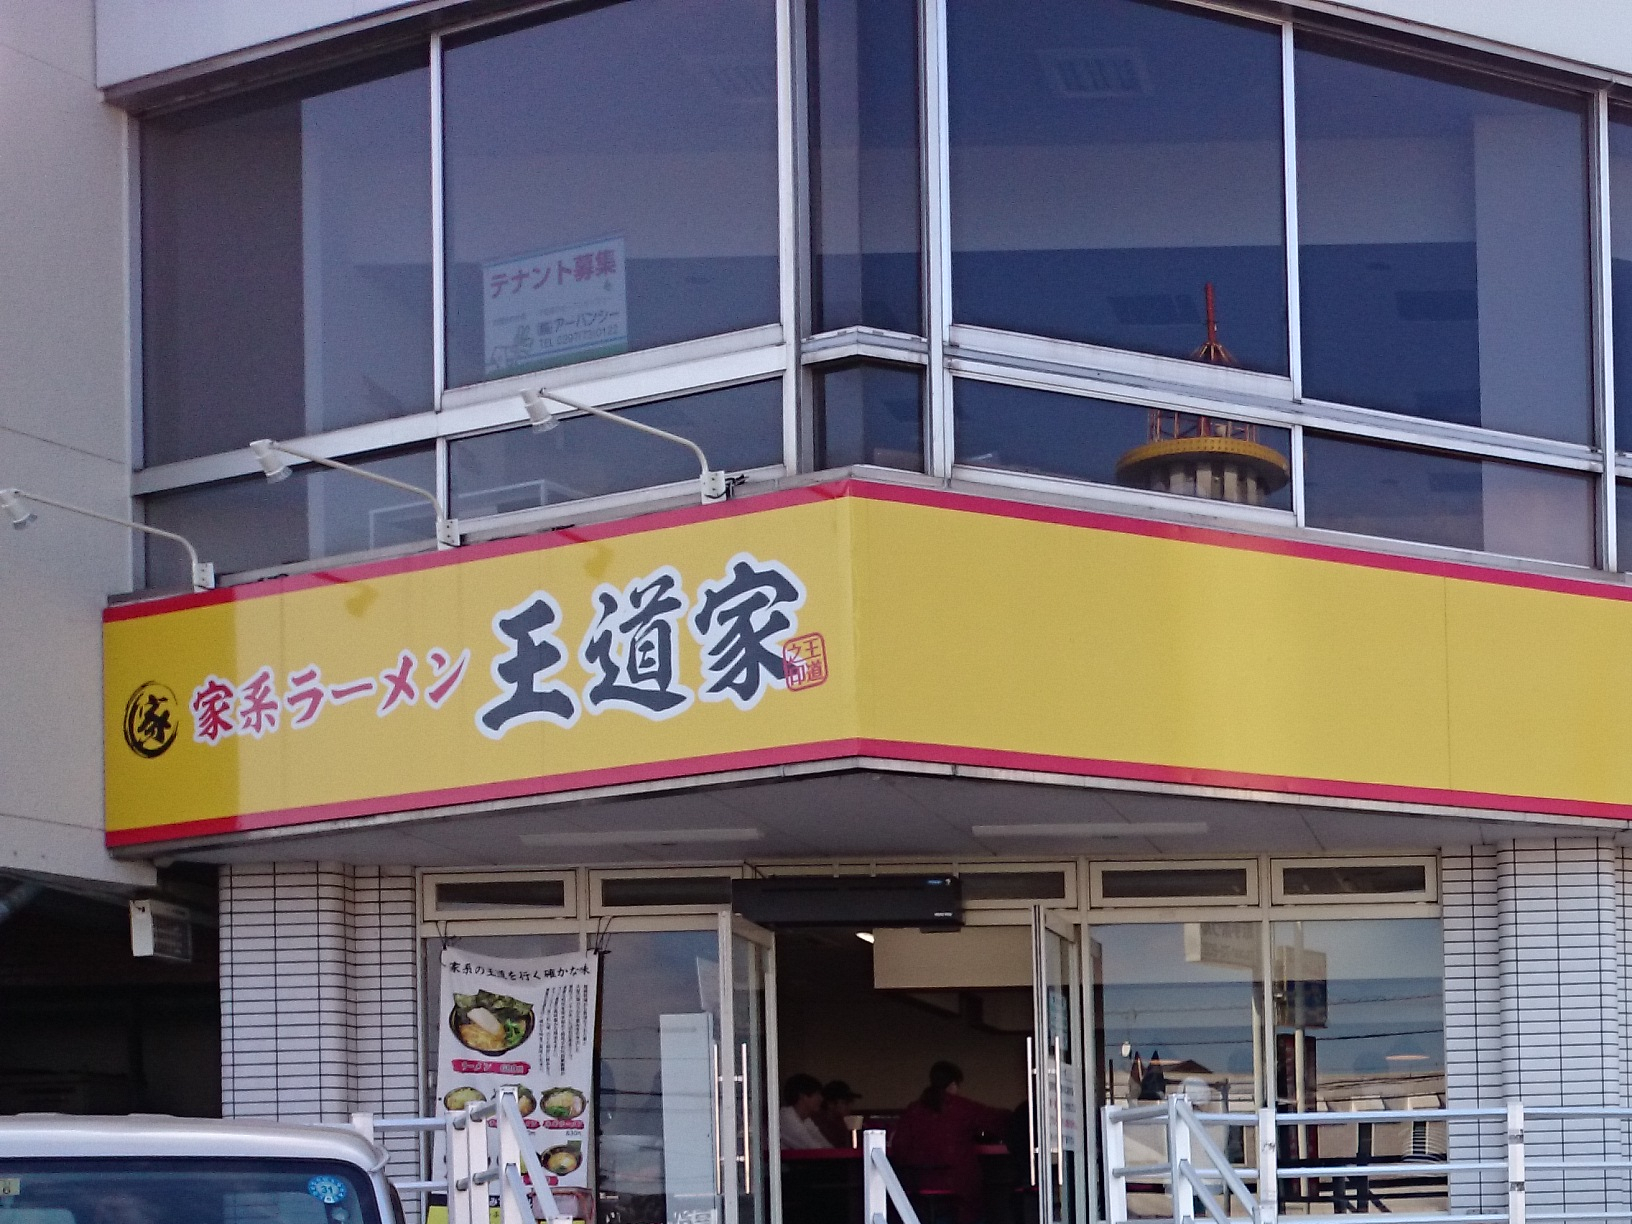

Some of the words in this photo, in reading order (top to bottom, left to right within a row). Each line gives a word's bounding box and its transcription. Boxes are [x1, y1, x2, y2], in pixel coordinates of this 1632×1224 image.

[490, 249, 616, 299] テナント募集
[193, 652, 467, 741] 家系ラーメン
[481, 561, 800, 731] 王道家
